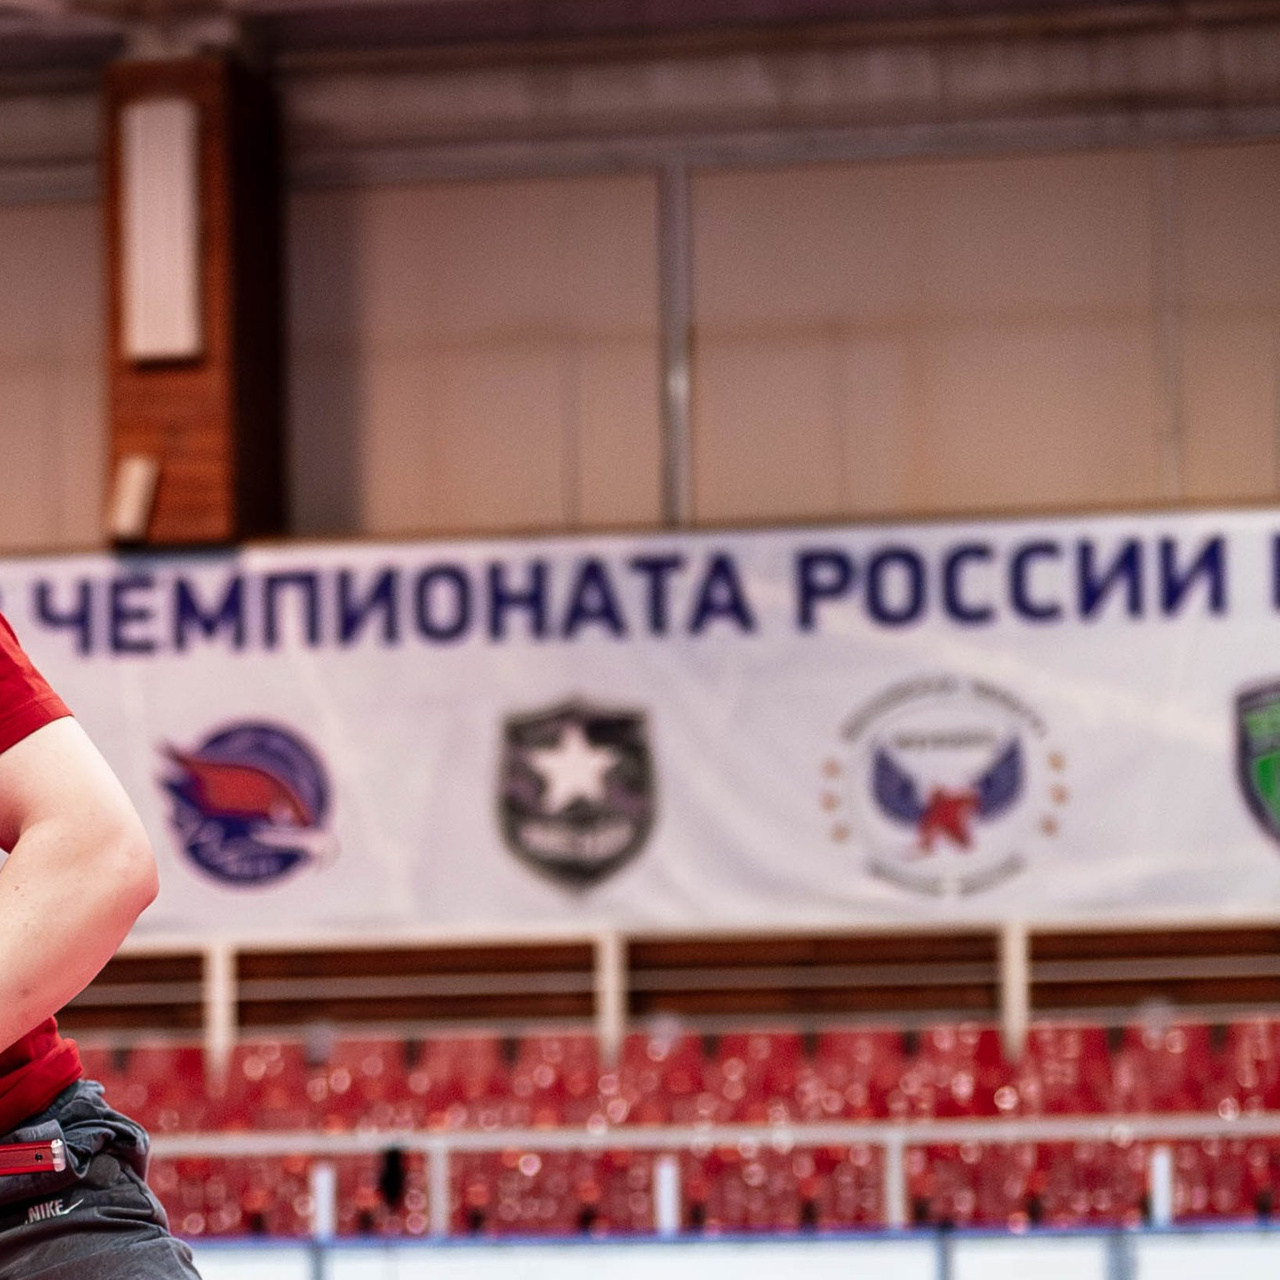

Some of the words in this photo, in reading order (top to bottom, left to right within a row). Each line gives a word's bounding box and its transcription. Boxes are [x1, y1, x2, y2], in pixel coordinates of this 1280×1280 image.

[31, 551, 756, 656] ЧЕМПИОНАТА
[795, 535, 1227, 632] РОССИИ
[27, 1198, 64, 1223] NIKE
